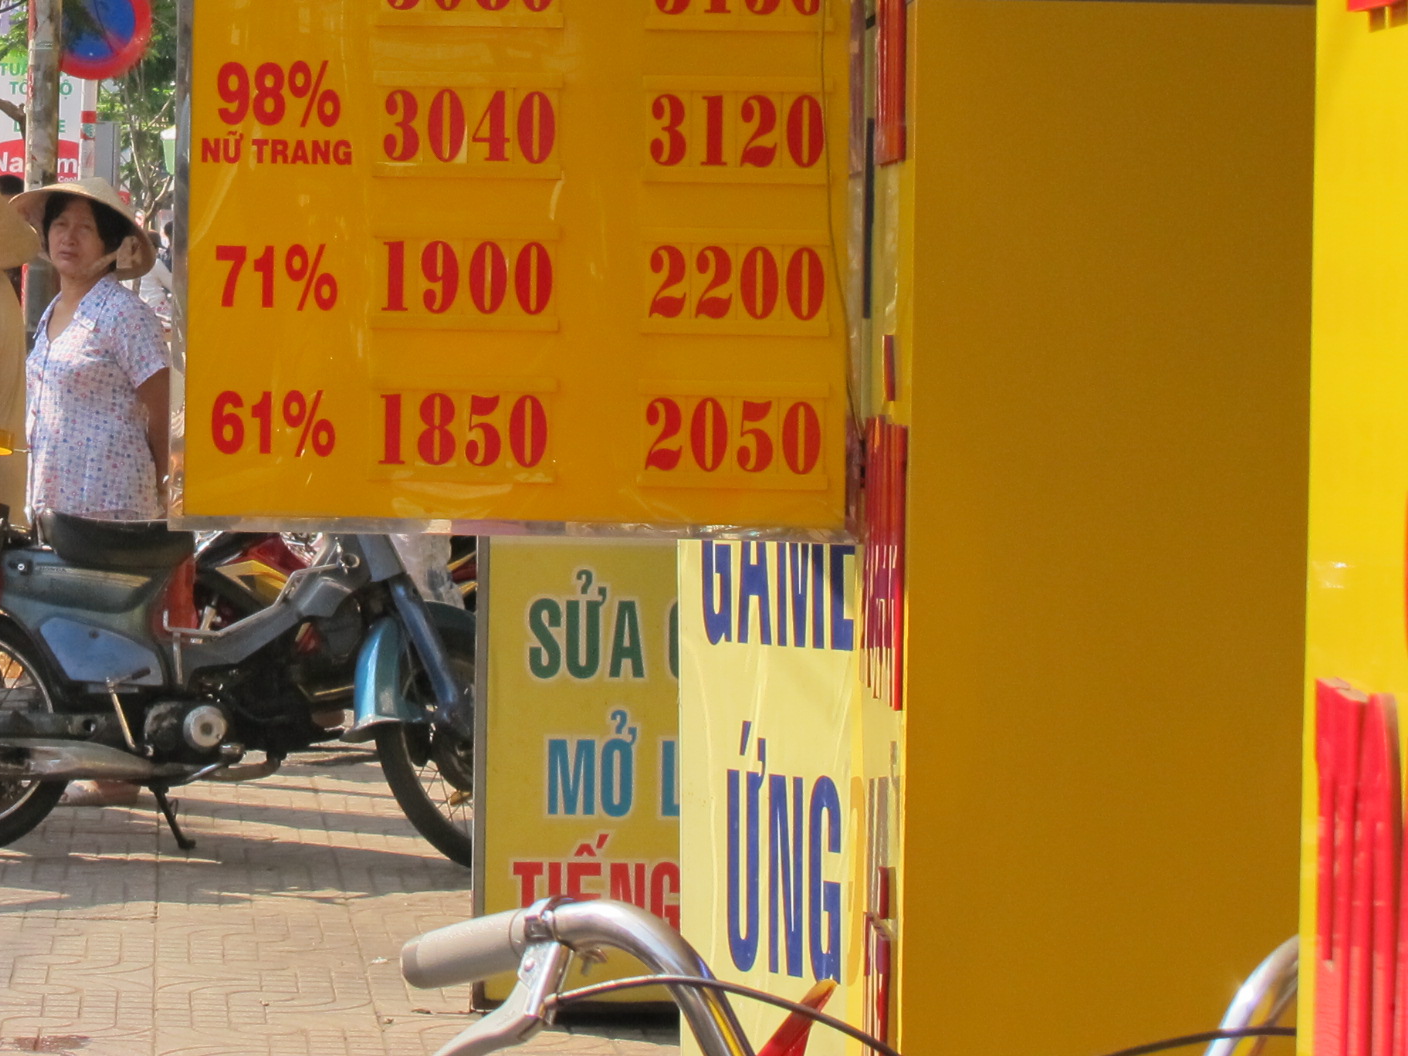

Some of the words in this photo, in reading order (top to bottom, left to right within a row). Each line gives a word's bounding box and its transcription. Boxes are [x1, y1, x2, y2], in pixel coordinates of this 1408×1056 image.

[200, 130, 243, 166] NỮ
[250, 137, 353, 167] TRANG
[216, 59, 341, 129] 98%
[382, 87, 556, 165] 3040
[649, 92, 825, 169] 3120
[214, 242, 339, 313] 71%
[379, 239, 554, 316] 1900
[648, 244, 825, 322] 2200
[210, 388, 337, 459] 61%
[377, 391, 548, 469] 1850
[644, 396, 823, 476] 2050
[527, 568, 646, 680] SỬA
[546, 709, 639, 818] MỞ
[726, 720, 842, 985] ỨNG
